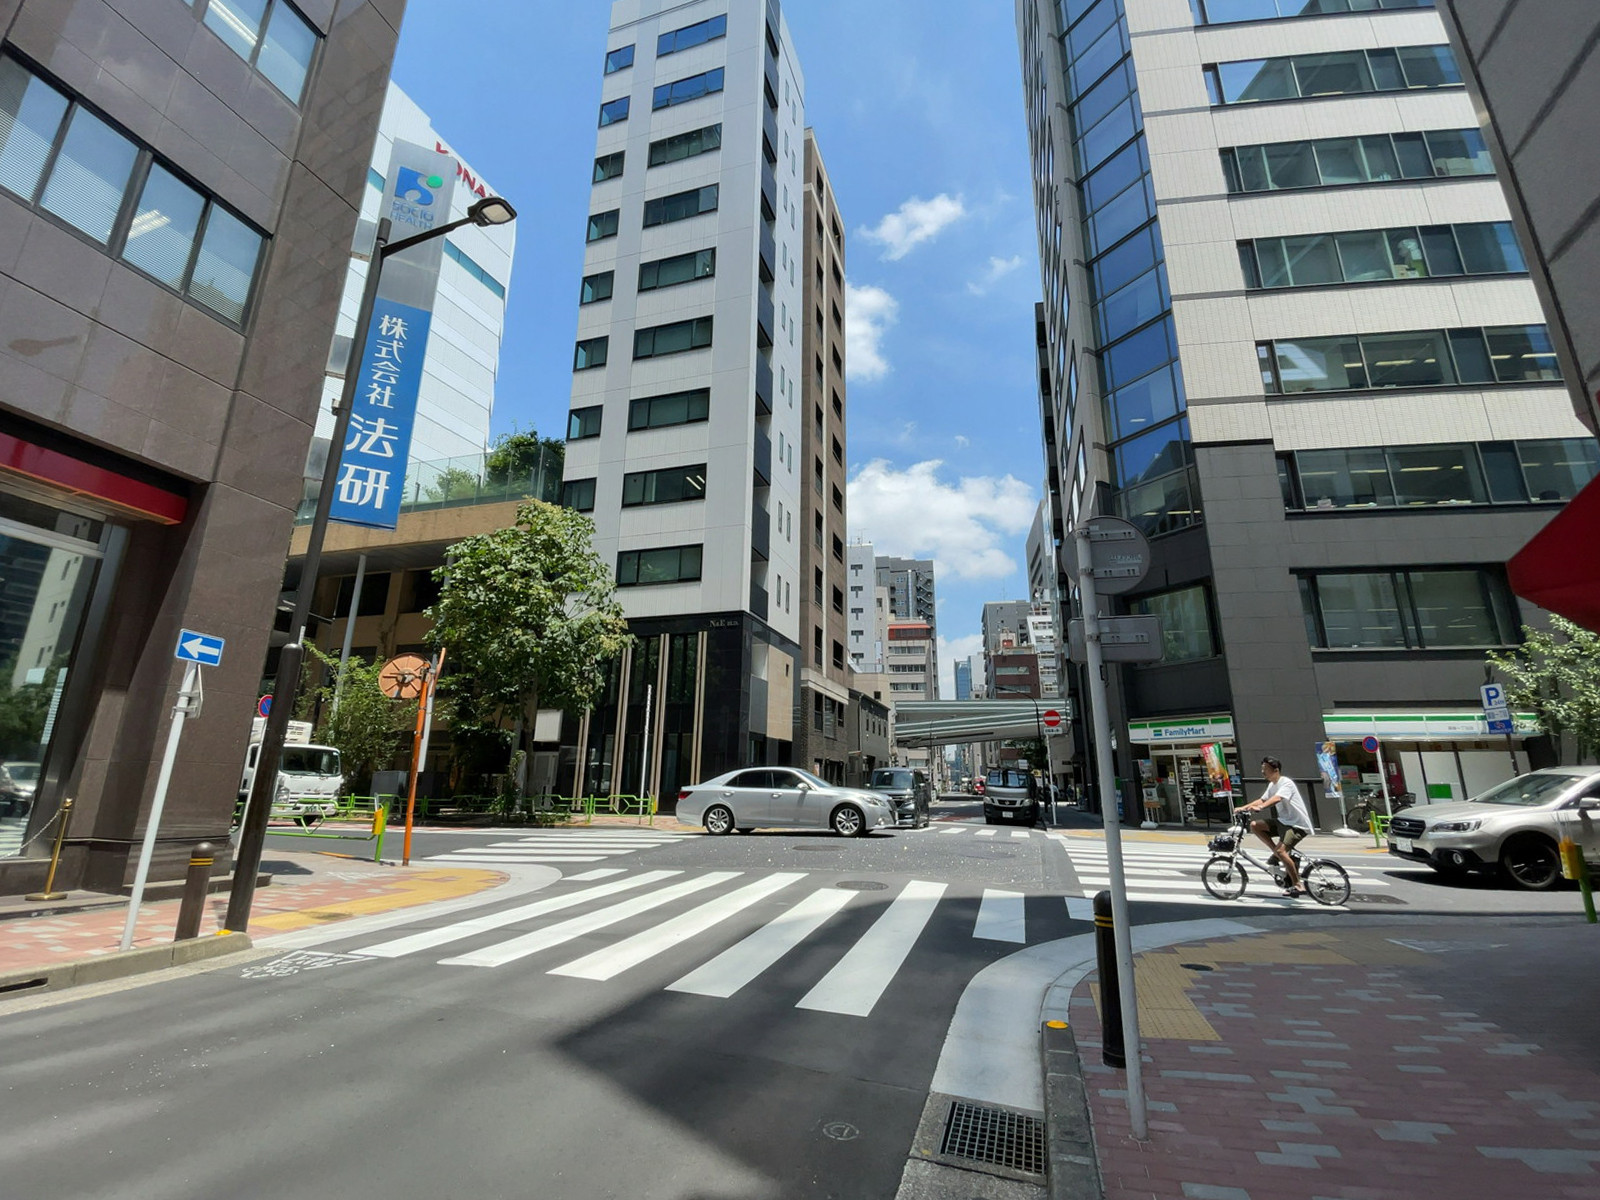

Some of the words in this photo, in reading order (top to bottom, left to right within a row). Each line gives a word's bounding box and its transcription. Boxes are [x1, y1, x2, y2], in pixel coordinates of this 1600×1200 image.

[390, 211, 433, 230] HEALTH
[366, 314, 408, 409] 株式会社
[337, 413, 399, 510] 法研
[1485, 687, 1499, 706] P
[1164, 727, 1206, 737] FamilyMart
[1180, 759, 1198, 821] FamilyMart
